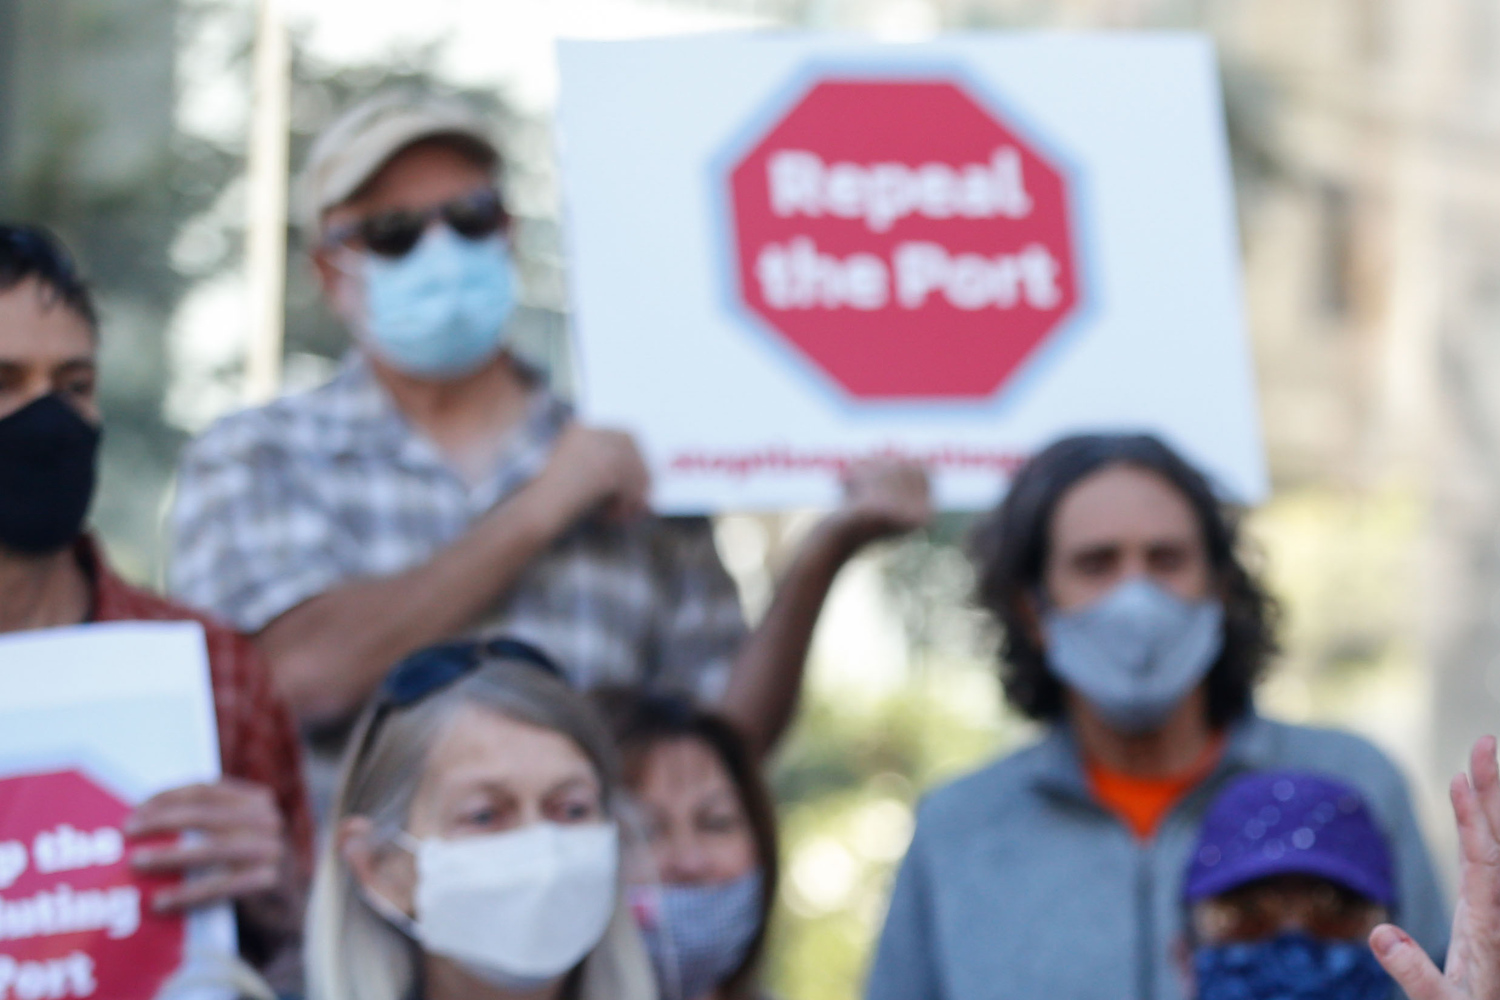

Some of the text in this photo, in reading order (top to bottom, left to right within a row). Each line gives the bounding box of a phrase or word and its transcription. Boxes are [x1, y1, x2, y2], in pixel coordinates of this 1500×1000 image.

[768, 146, 1031, 232] Repeal
[756, 236, 1061, 309] the Port
[34, 825, 124, 873] the
